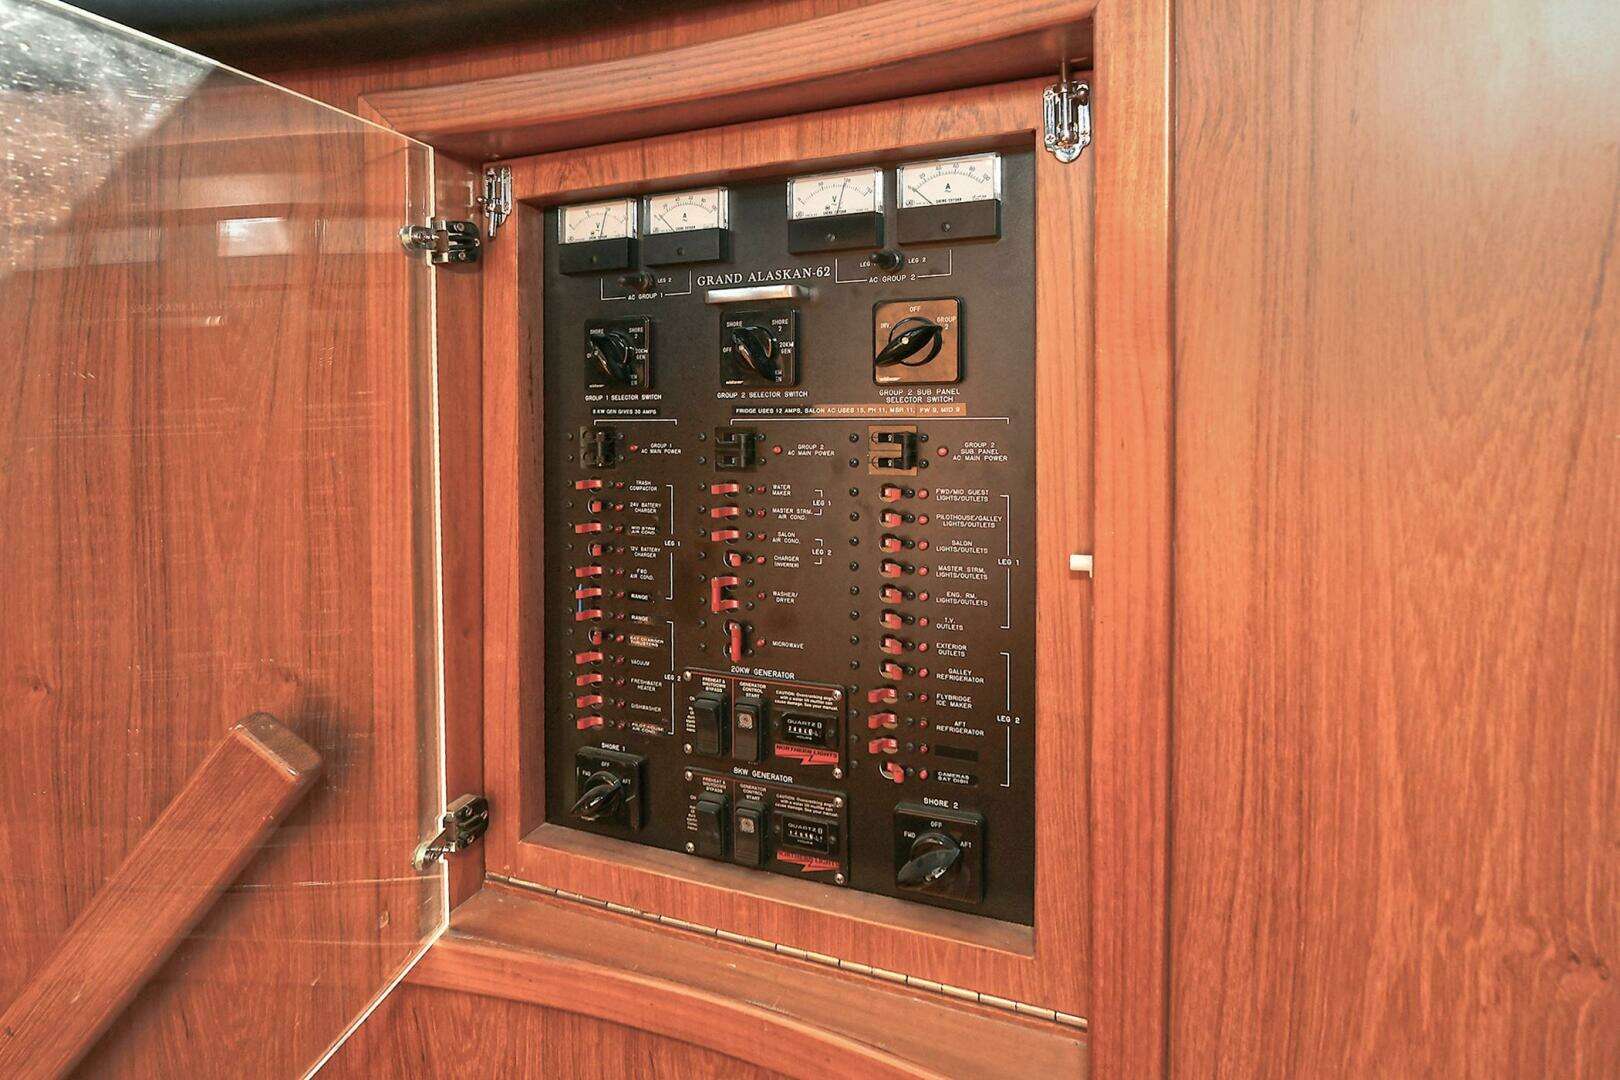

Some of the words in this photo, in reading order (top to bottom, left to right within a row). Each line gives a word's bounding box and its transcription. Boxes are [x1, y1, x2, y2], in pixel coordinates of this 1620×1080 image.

[697, 273, 743, 287] GRAND
[748, 266, 831, 282] ALASKAN-62
[869, 276, 880, 284] AC
[882, 274, 907, 283] GROUP
[784, 390, 808, 398] SWITCH
[879, 389, 904, 397] GROUP
[916, 388, 932, 396] SUB
[886, 396, 923, 404] SELECTOR
[935, 513, 1003, 522] PILOTHOUSE/GALLEY
[936, 546, 988, 554] LIGHTS/OUTLETS
[997, 558, 1012, 566] LEG
[936, 572, 988, 580] LIGHTS/OUTLETS
[936, 597, 988, 607] LIGHTS/OUTLETS
[631, 614, 649, 622] RANGE
[936, 623, 964, 631] OUTLETS
[772, 640, 805, 650] MICROWAVE
[936, 642, 967, 651] EXTERIOR
[938, 649, 966, 657] OUTLETS
[730, 665, 750, 675] 20KW
[753, 668, 795, 680] GENERATOR
[947, 668, 972, 676] GALLEY
[664, 673, 675, 681] LEG
[936, 673, 985, 684] REFRIGERATOR
[637, 684, 656, 692] HEATER
[936, 693, 972, 703] FLYBRIDGE
[936, 699, 946, 707] ICE
[949, 701, 973, 709] MAKER
[996, 715, 1011, 723] LEG
[936, 725, 985, 736] REFRIGERATOR
[601, 742, 620, 751] SHORE
[733, 766, 749, 776] 8KW
[752, 770, 793, 784] GENERATOR
[923, 797, 949, 808] SHORE
[953, 802, 959, 810] 2
[903, 830, 916, 839] FWD
